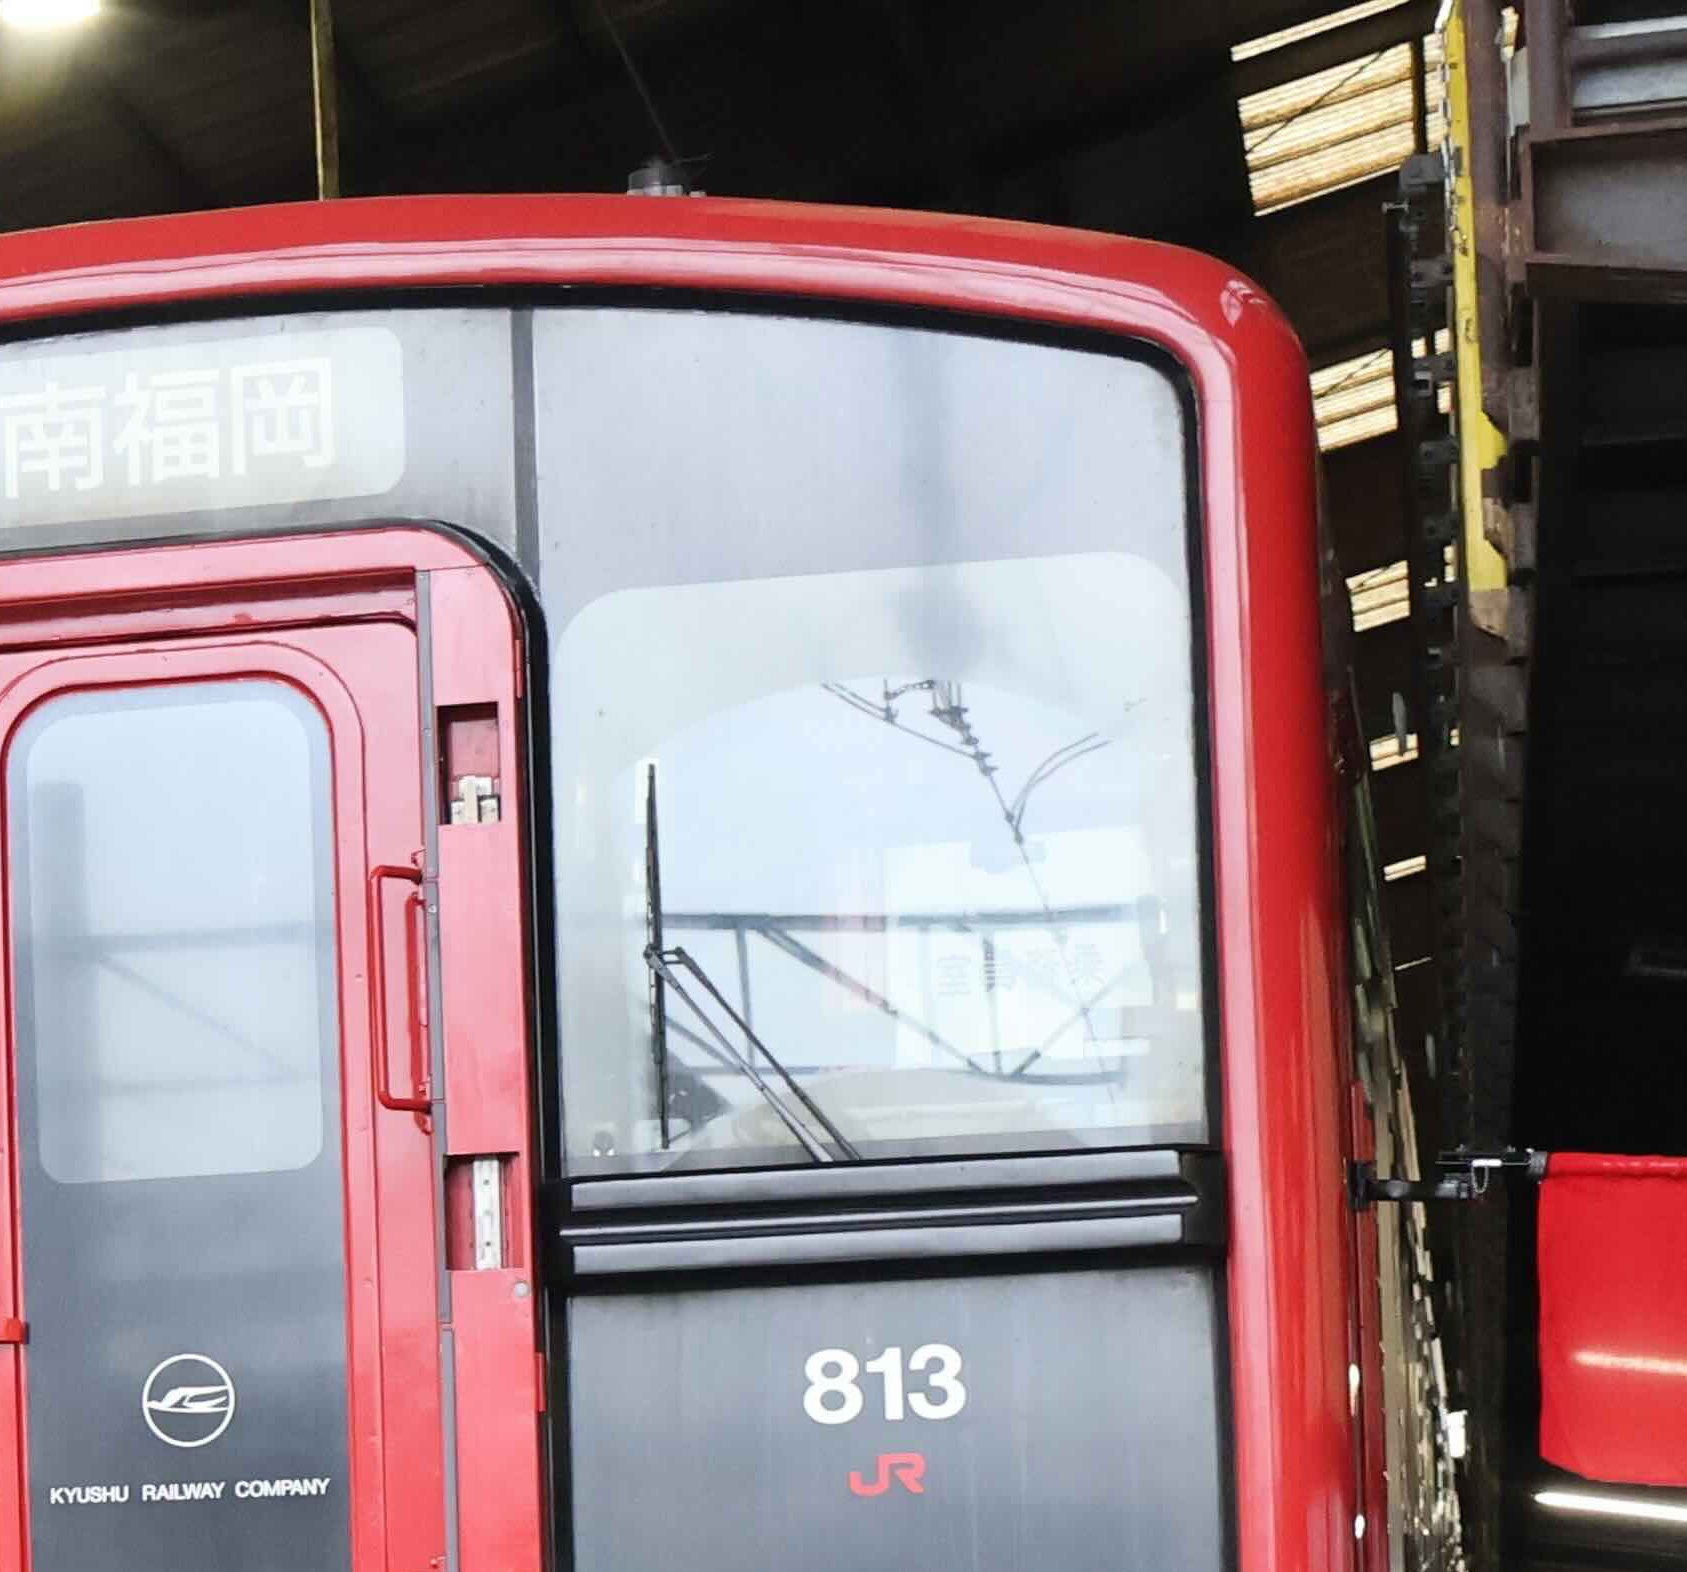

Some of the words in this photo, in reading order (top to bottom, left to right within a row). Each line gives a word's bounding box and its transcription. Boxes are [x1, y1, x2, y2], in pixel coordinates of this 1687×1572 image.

[803, 1343, 967, 1425] 813
[49, 1485, 129, 1506] KYUSHU
[141, 1481, 226, 1502] RAILWAY
[234, 1477, 332, 1498] COMPANY
[848, 1452, 928, 1497] JR
